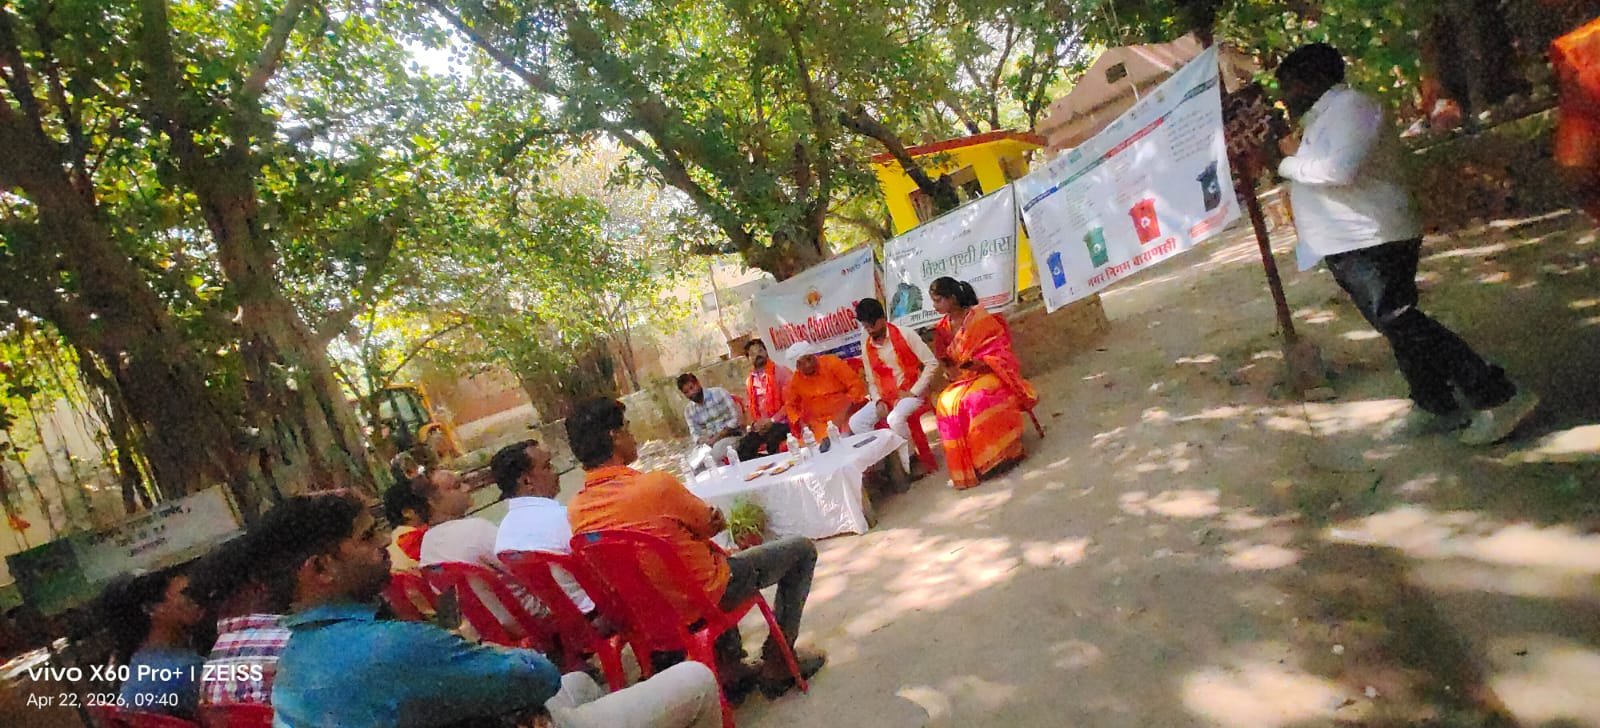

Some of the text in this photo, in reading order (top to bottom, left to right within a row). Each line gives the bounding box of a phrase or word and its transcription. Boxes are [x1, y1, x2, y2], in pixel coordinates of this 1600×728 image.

[949, 244, 977, 275] पृथ्वी
[1086, 273, 1106, 288] नगर
[1105, 261, 1131, 280] निगम
[806, 305, 859, 343] Charitable
